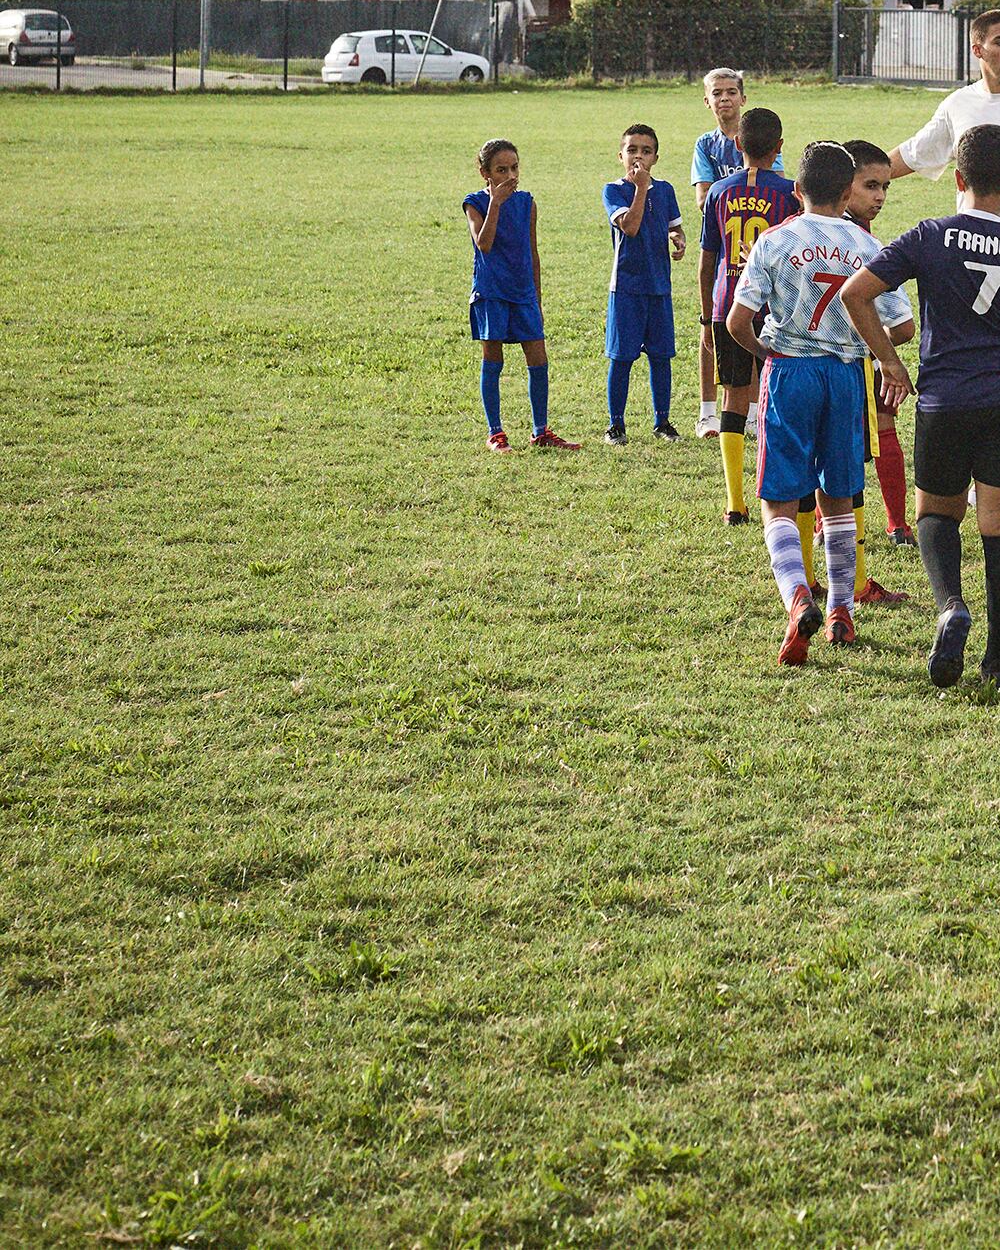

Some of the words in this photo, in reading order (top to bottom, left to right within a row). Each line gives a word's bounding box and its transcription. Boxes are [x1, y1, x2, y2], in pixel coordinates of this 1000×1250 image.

[727, 197, 772, 215] MESSI
[725, 216, 770, 265] 10
[808, 272, 849, 332] 7
